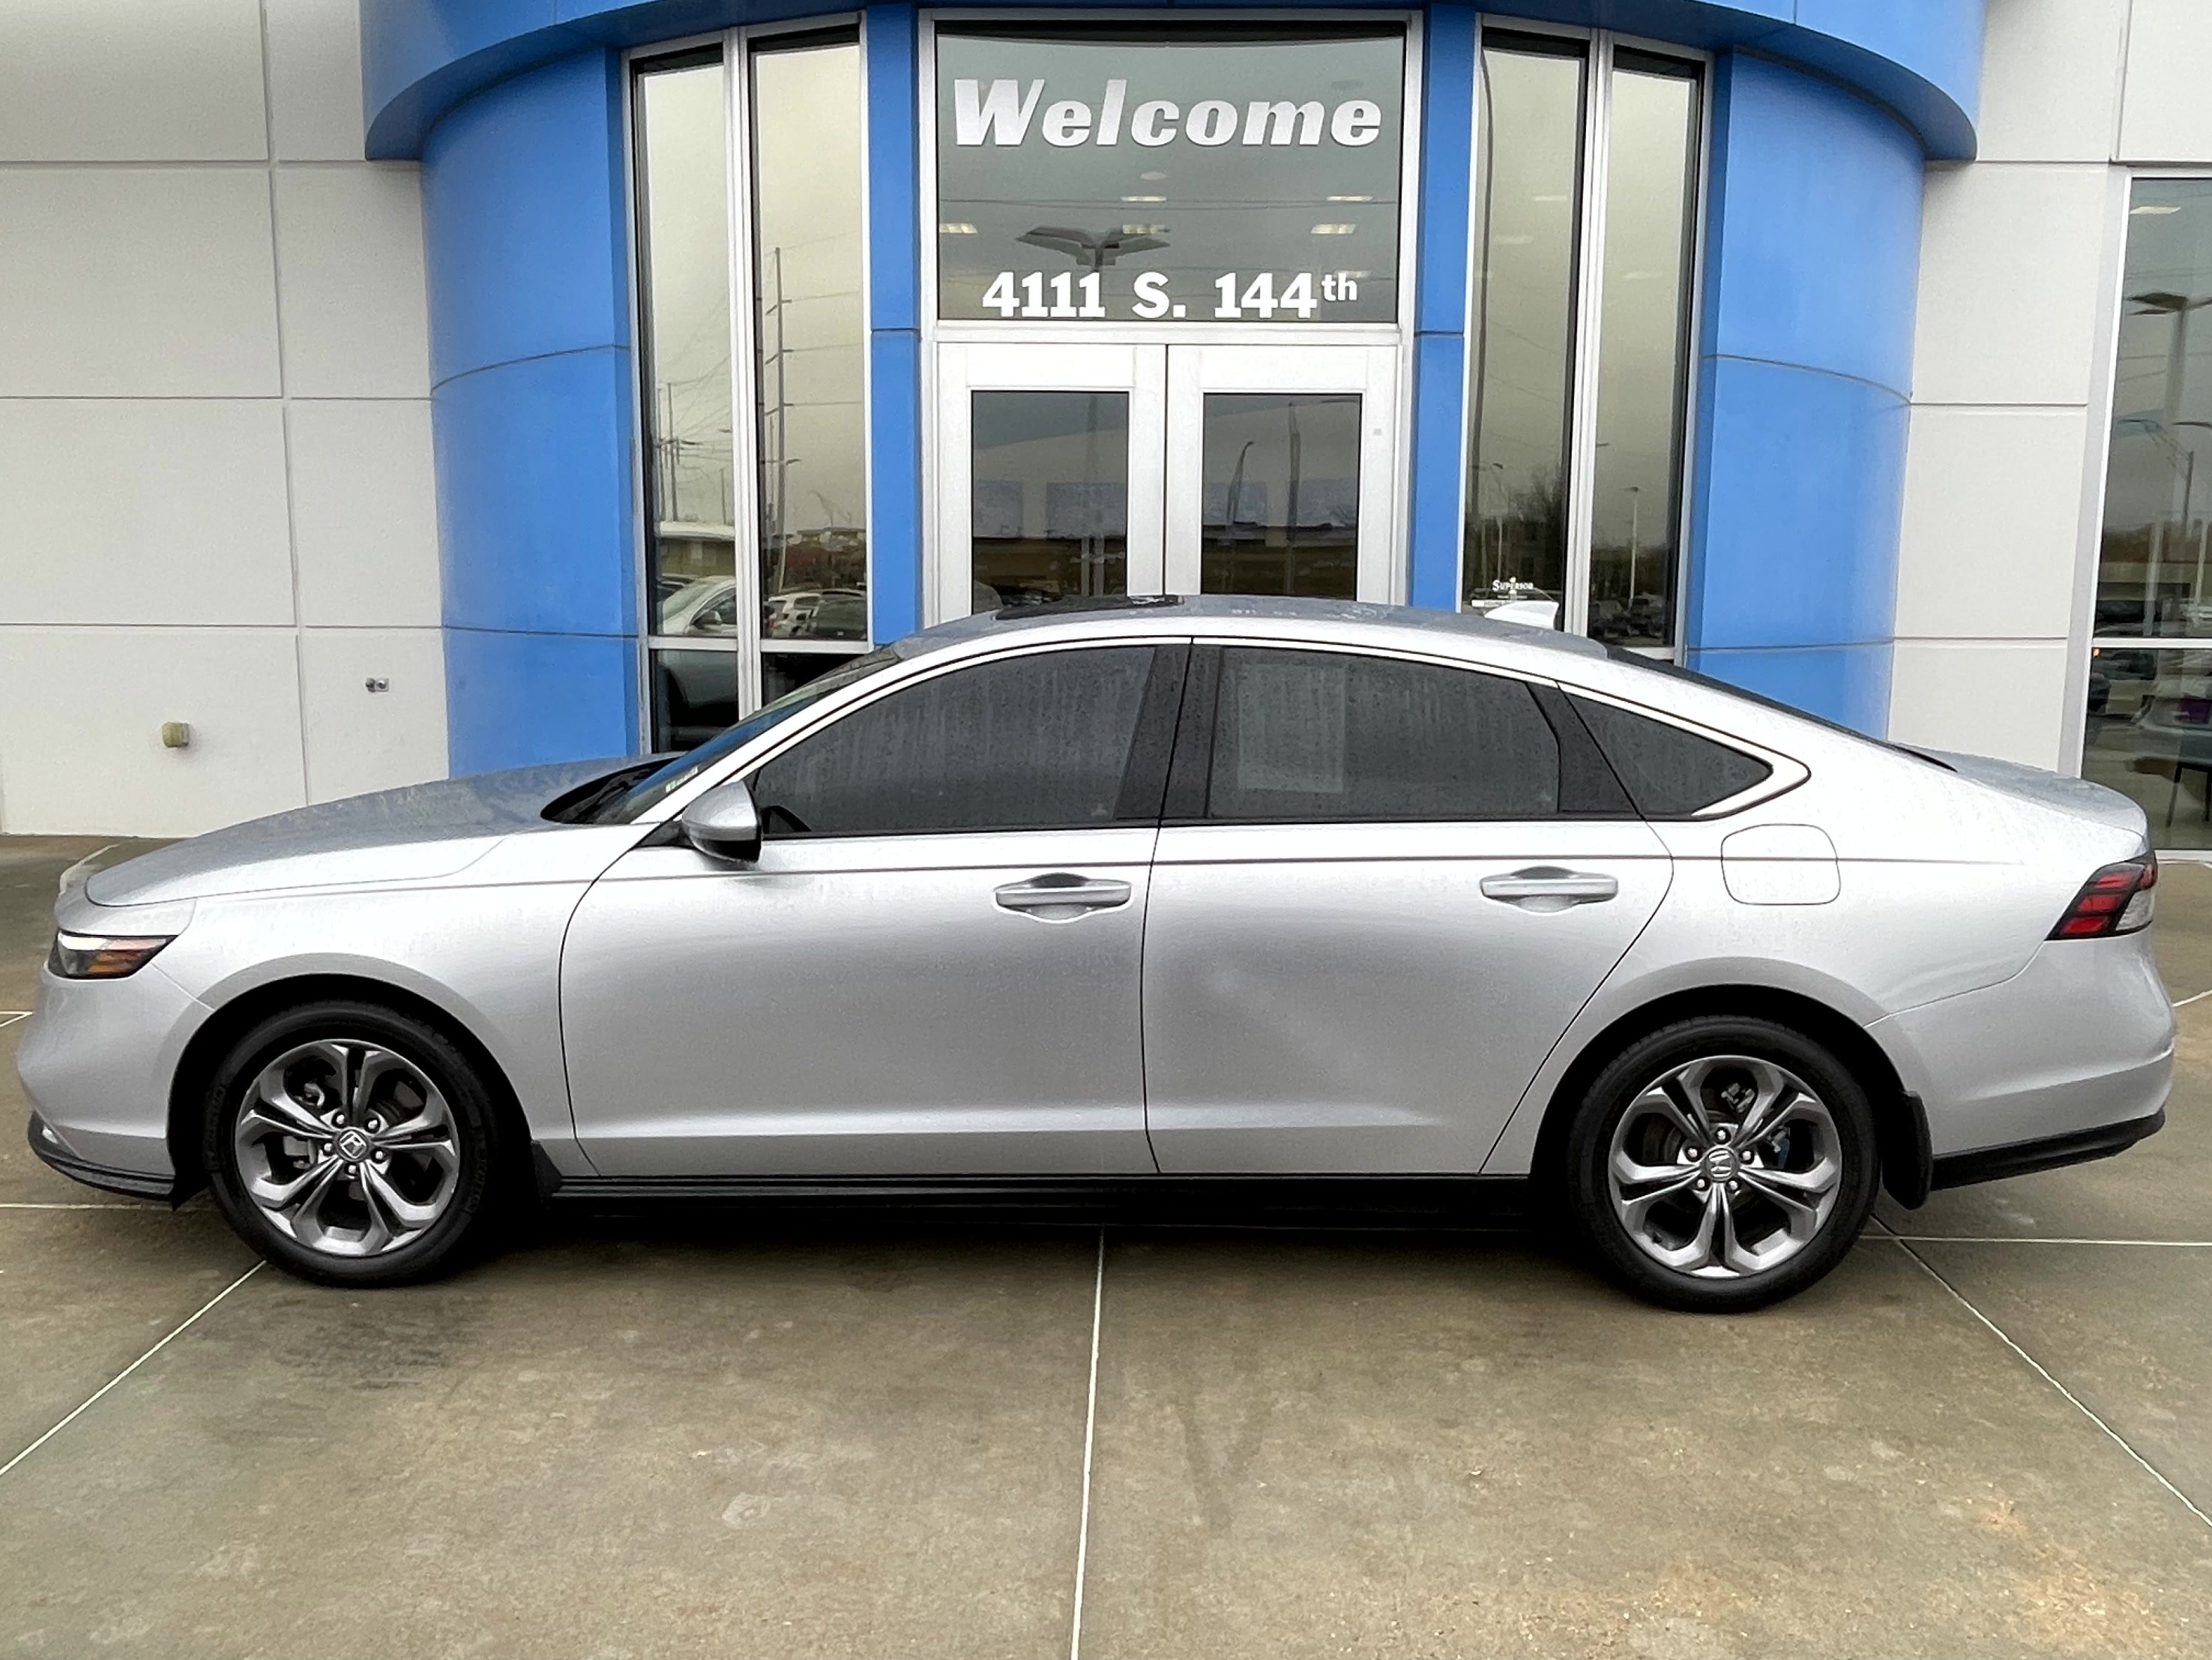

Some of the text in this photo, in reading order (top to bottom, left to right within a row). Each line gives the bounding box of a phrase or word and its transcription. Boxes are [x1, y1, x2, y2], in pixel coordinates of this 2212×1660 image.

[953, 79, 1381, 146] Welcome
[982, 271, 1357, 319] 4111 S. 144th
